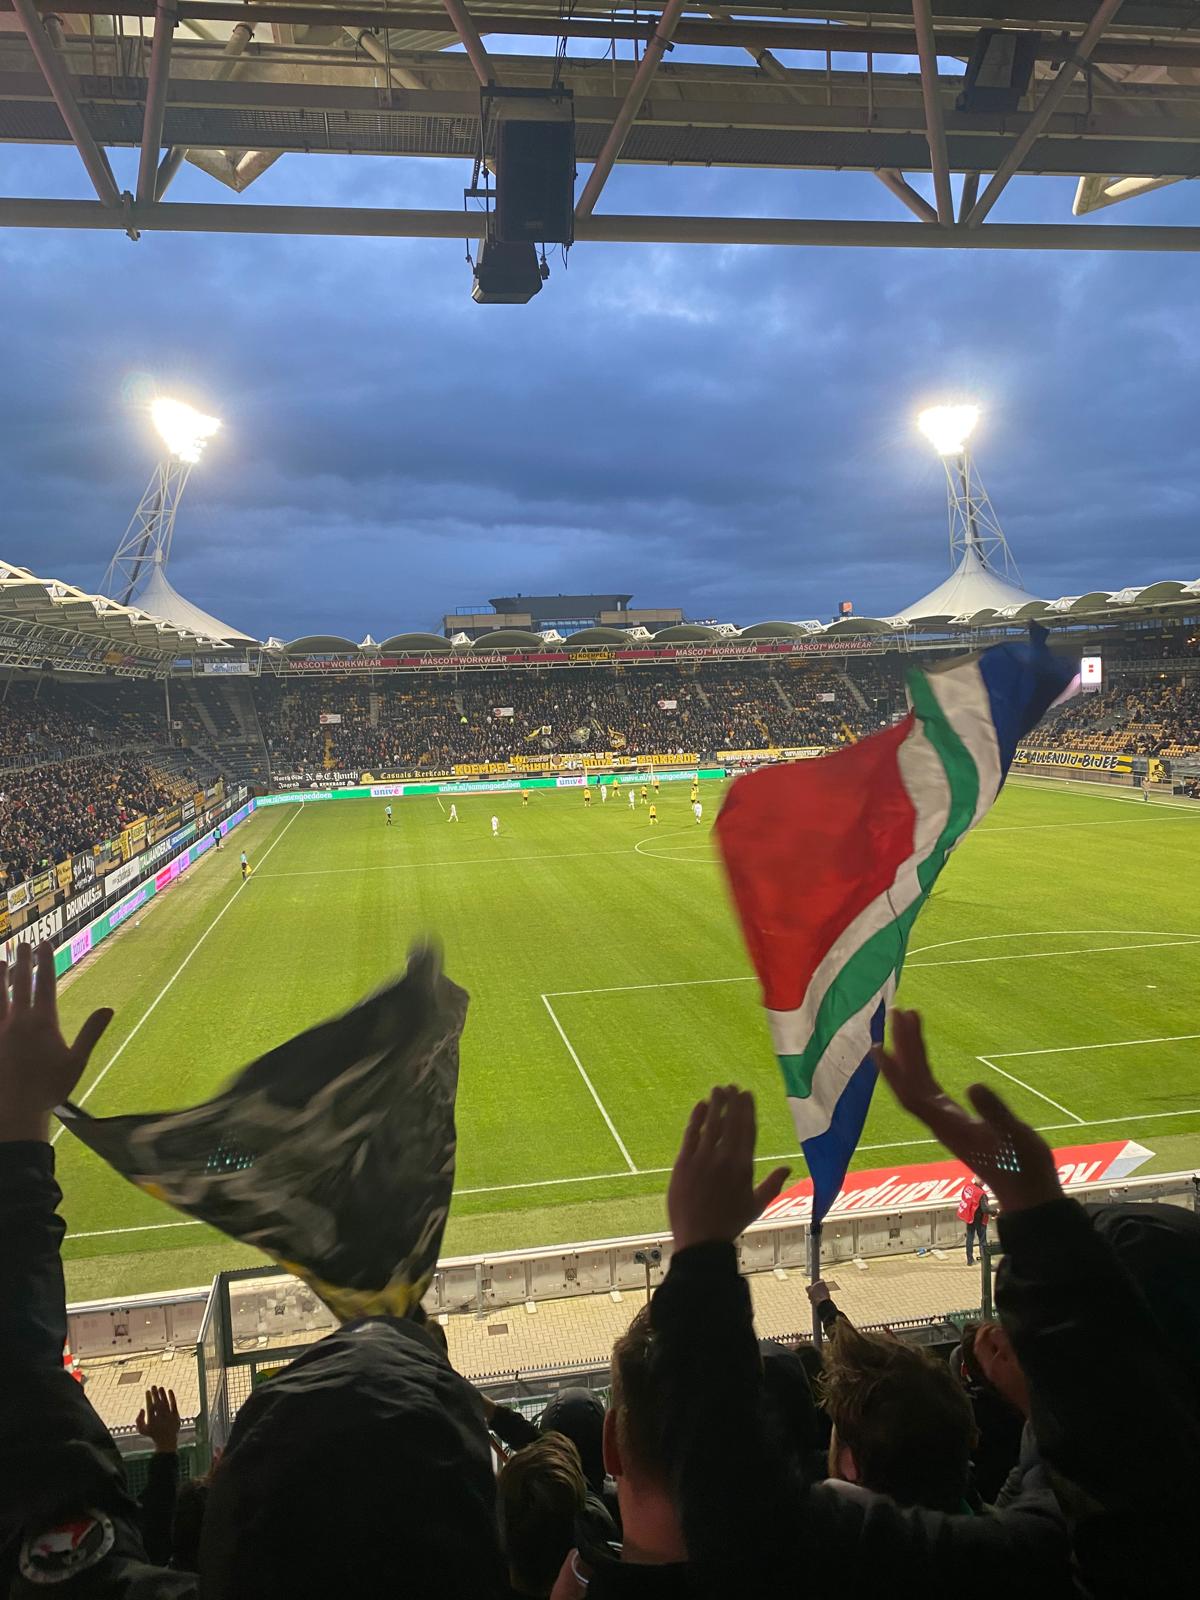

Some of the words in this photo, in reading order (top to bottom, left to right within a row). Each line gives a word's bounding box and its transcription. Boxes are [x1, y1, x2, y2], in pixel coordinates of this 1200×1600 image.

[827, 641, 872, 650] WORKWEAR
[712, 646, 757, 655] WORKWEAR
[331, 659, 381, 668] WORKWEAR
[459, 655, 507, 664] WORKWEAR
